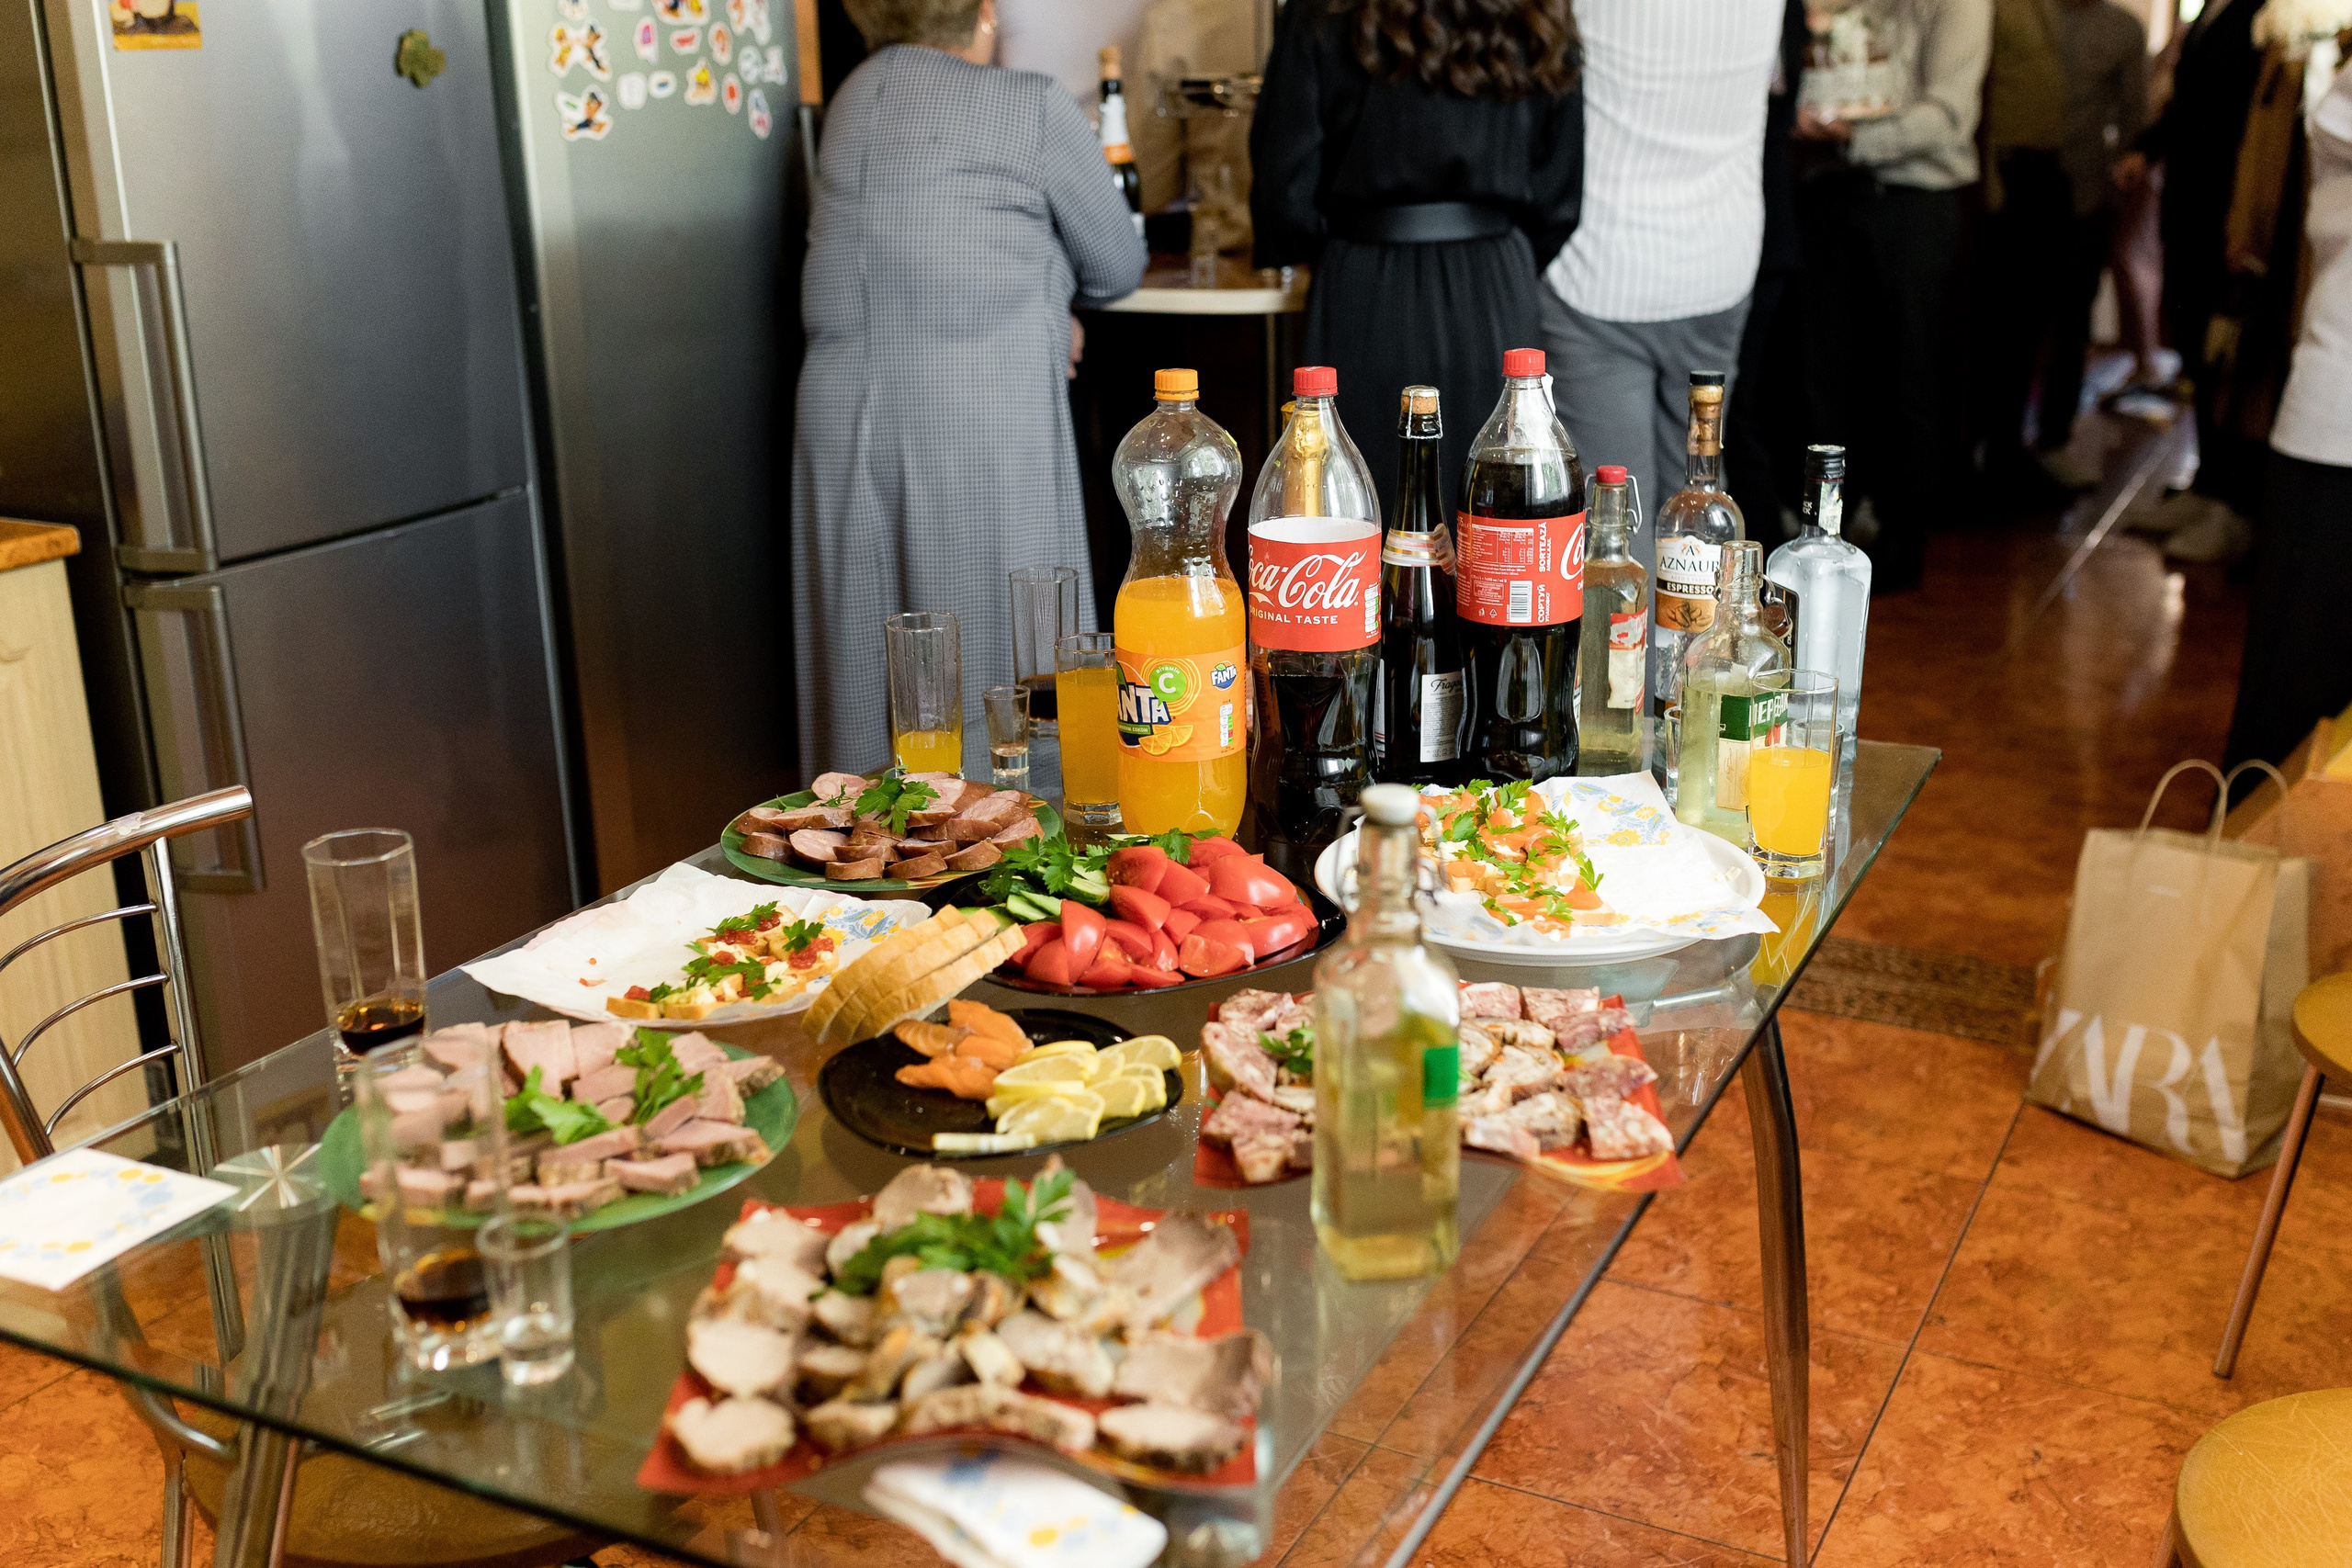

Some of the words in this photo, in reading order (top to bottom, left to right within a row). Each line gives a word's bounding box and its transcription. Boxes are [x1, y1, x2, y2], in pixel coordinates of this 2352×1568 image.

[1538, 522, 1547, 572] SORTEAZĂ
[1667, 582, 1714, 594] ESPRESSO
[1295, 615, 1338, 625] TASTE
[1212, 666, 1237, 685] FANTA
[2030, 1009, 2248, 1163] ZARA
